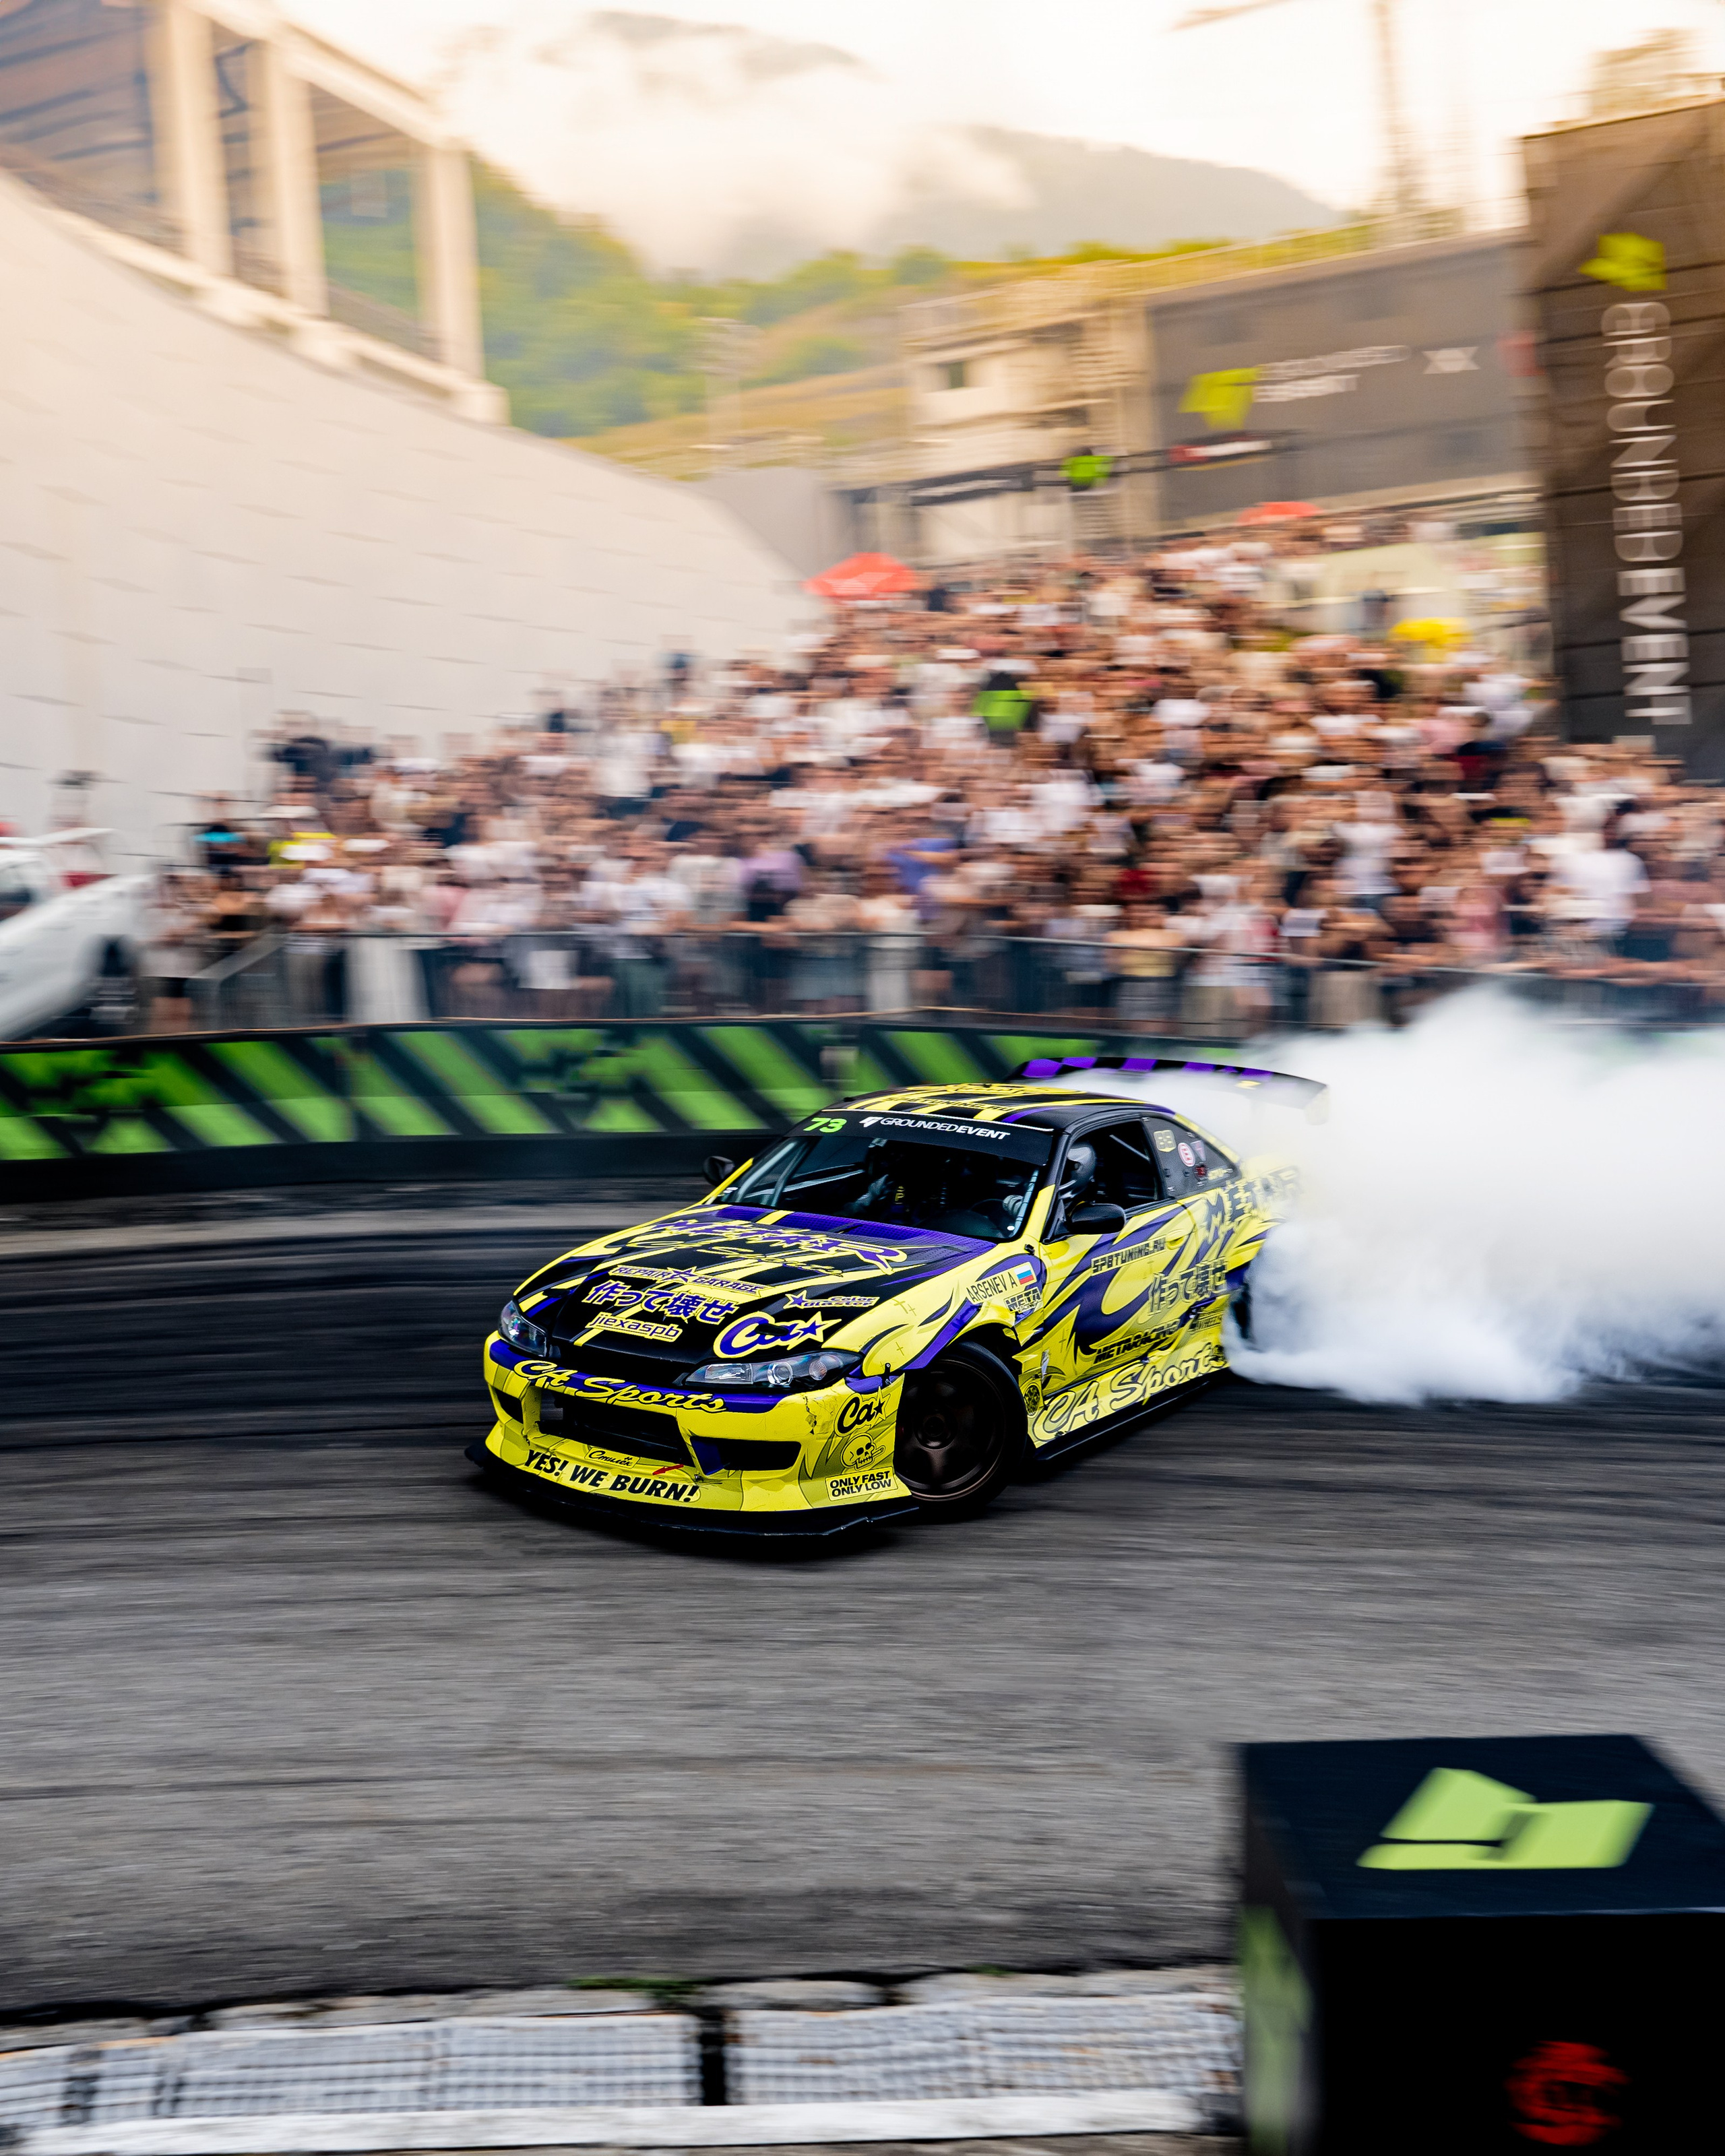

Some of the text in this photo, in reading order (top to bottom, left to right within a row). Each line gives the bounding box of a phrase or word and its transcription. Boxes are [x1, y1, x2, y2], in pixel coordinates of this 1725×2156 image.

[803, 1116, 847, 1133] 73
[613, 1267, 765, 1294] REPAIR GARAGE
[966, 1272, 1017, 1303] ARSENEV A
[584, 1281, 739, 1323] 作って壊せ
[590, 1313, 682, 1338] jiexaspb
[513, 1360, 726, 1412] CA Sports
[1034, 1381, 1100, 1442] CA
[524, 1449, 699, 1502] YES! WE BURN!
[829, 1471, 890, 1489] ONLY FAST
[832, 1479, 891, 1497] ONLY LOW
